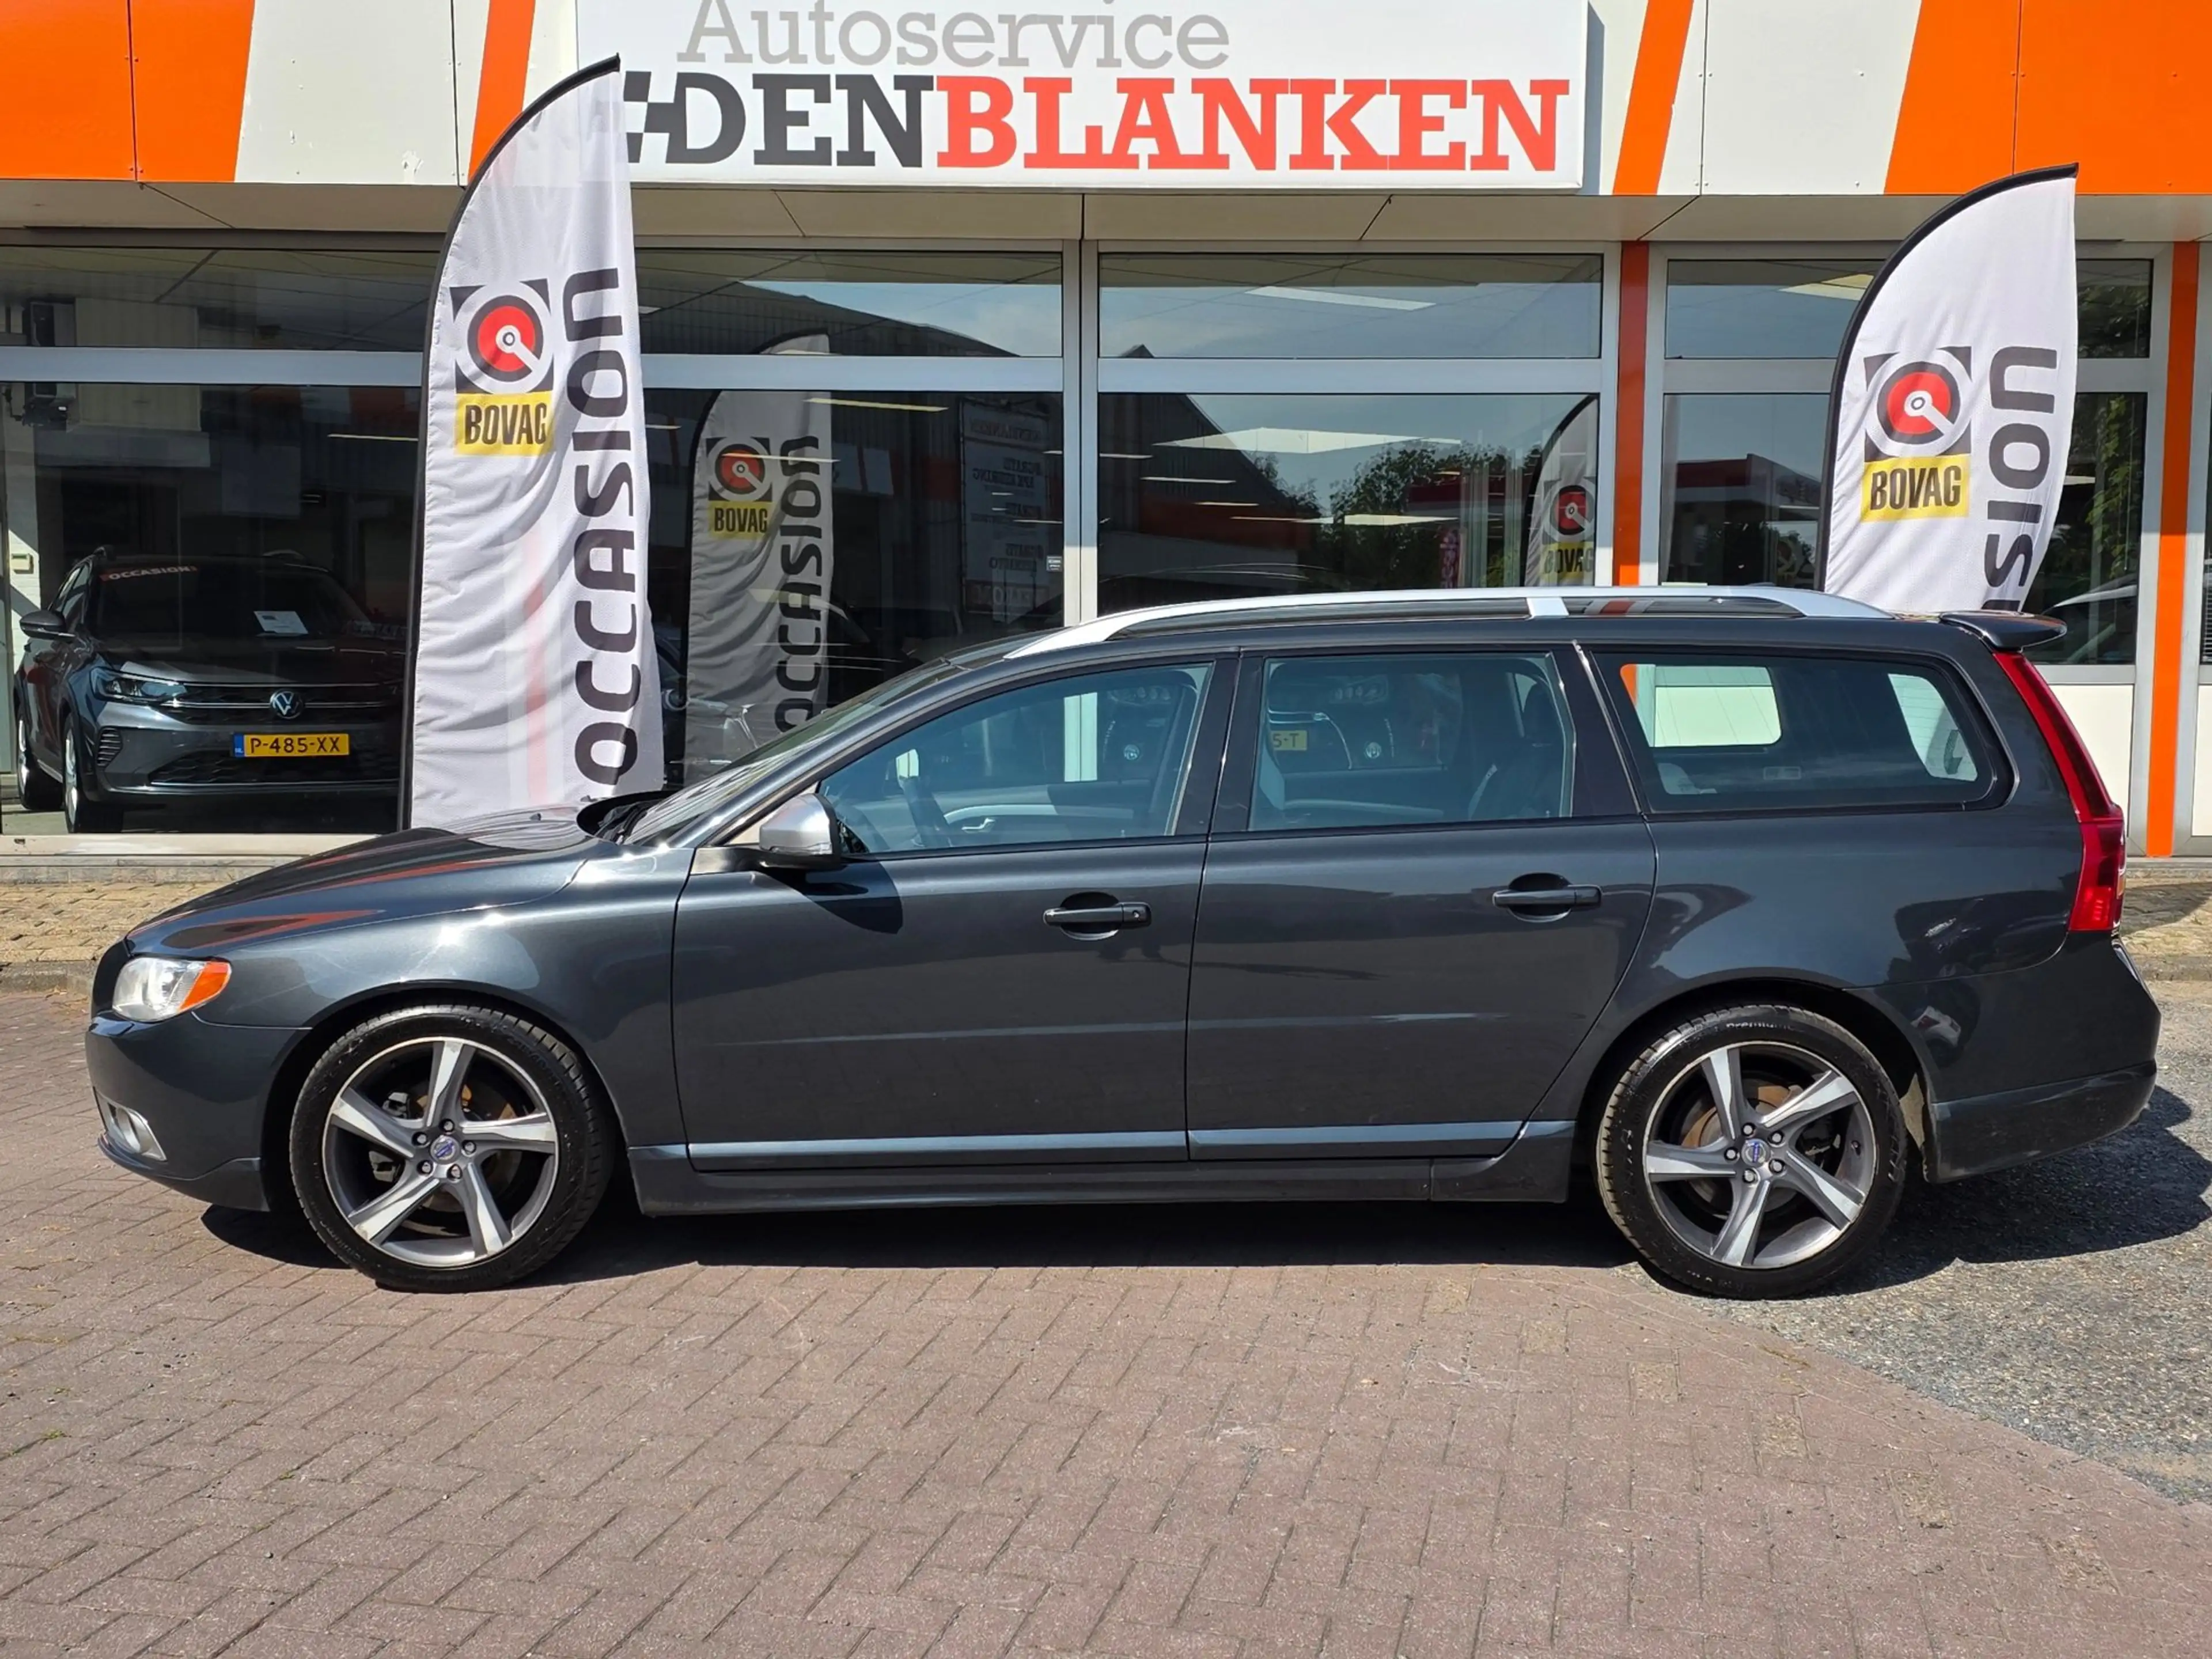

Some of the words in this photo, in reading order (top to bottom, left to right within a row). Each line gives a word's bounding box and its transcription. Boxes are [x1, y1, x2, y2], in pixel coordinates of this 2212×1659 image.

[677, 0, 1229, 69] Autoservice
[464, 402, 548, 445] BOVAG
[1869, 467, 1961, 511] BOVAG
[1980, 346, 2058, 611] SION
[714, 507, 768, 533] BOVAG
[251, 737, 340, 754] P-485-XX
